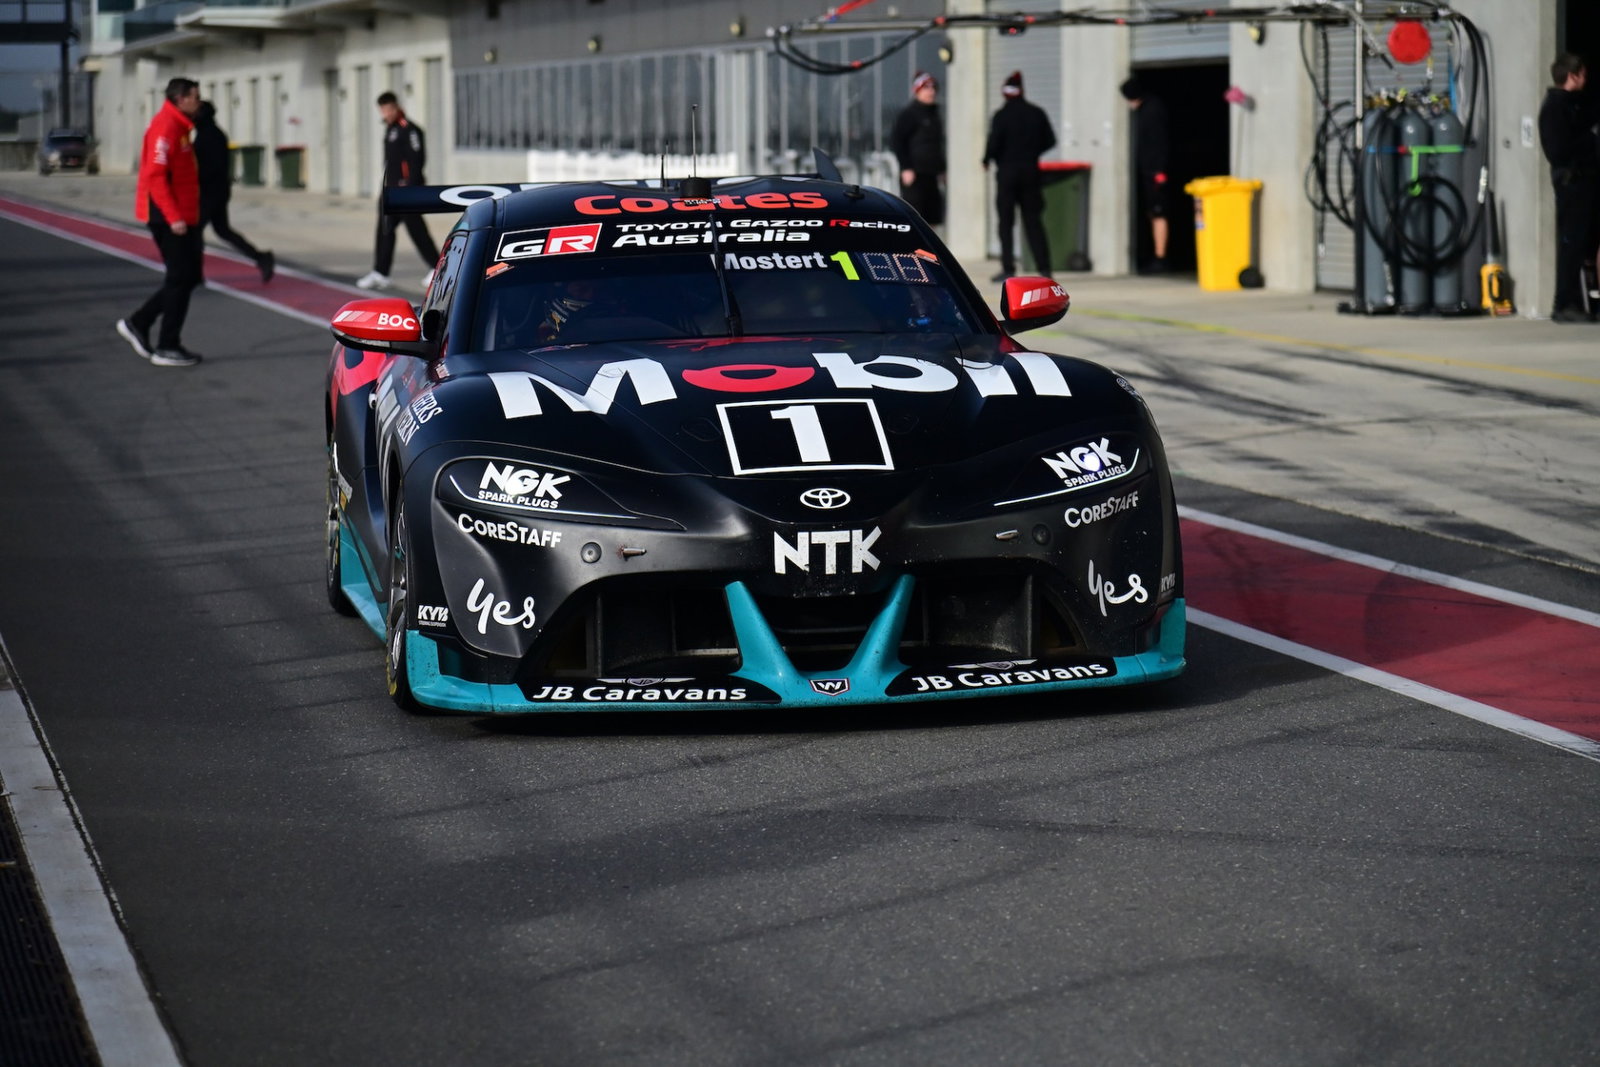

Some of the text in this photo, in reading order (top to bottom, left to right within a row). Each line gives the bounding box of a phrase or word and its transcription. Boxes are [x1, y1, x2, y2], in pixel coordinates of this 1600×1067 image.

[616, 219, 911, 232] TOYOTA GAZOO Racing
[501, 235, 594, 258] GR
[611, 229, 810, 248] Australia
[710, 251, 860, 281] Mostert 1
[377, 313, 416, 330] BOC
[487, 352, 1073, 419] Mobil
[770, 404, 831, 463] 1
[1041, 437, 1122, 479] NGK
[479, 461, 571, 500] NGK
[1064, 464, 1127, 488] SPARK PLUGS
[478, 490, 559, 509] SPARK PLUGS
[773, 526, 882, 575] NTK
[418, 604, 449, 621] KYB
[912, 663, 1108, 691] JB Caravans
[532, 686, 747, 700] JB Caravans
